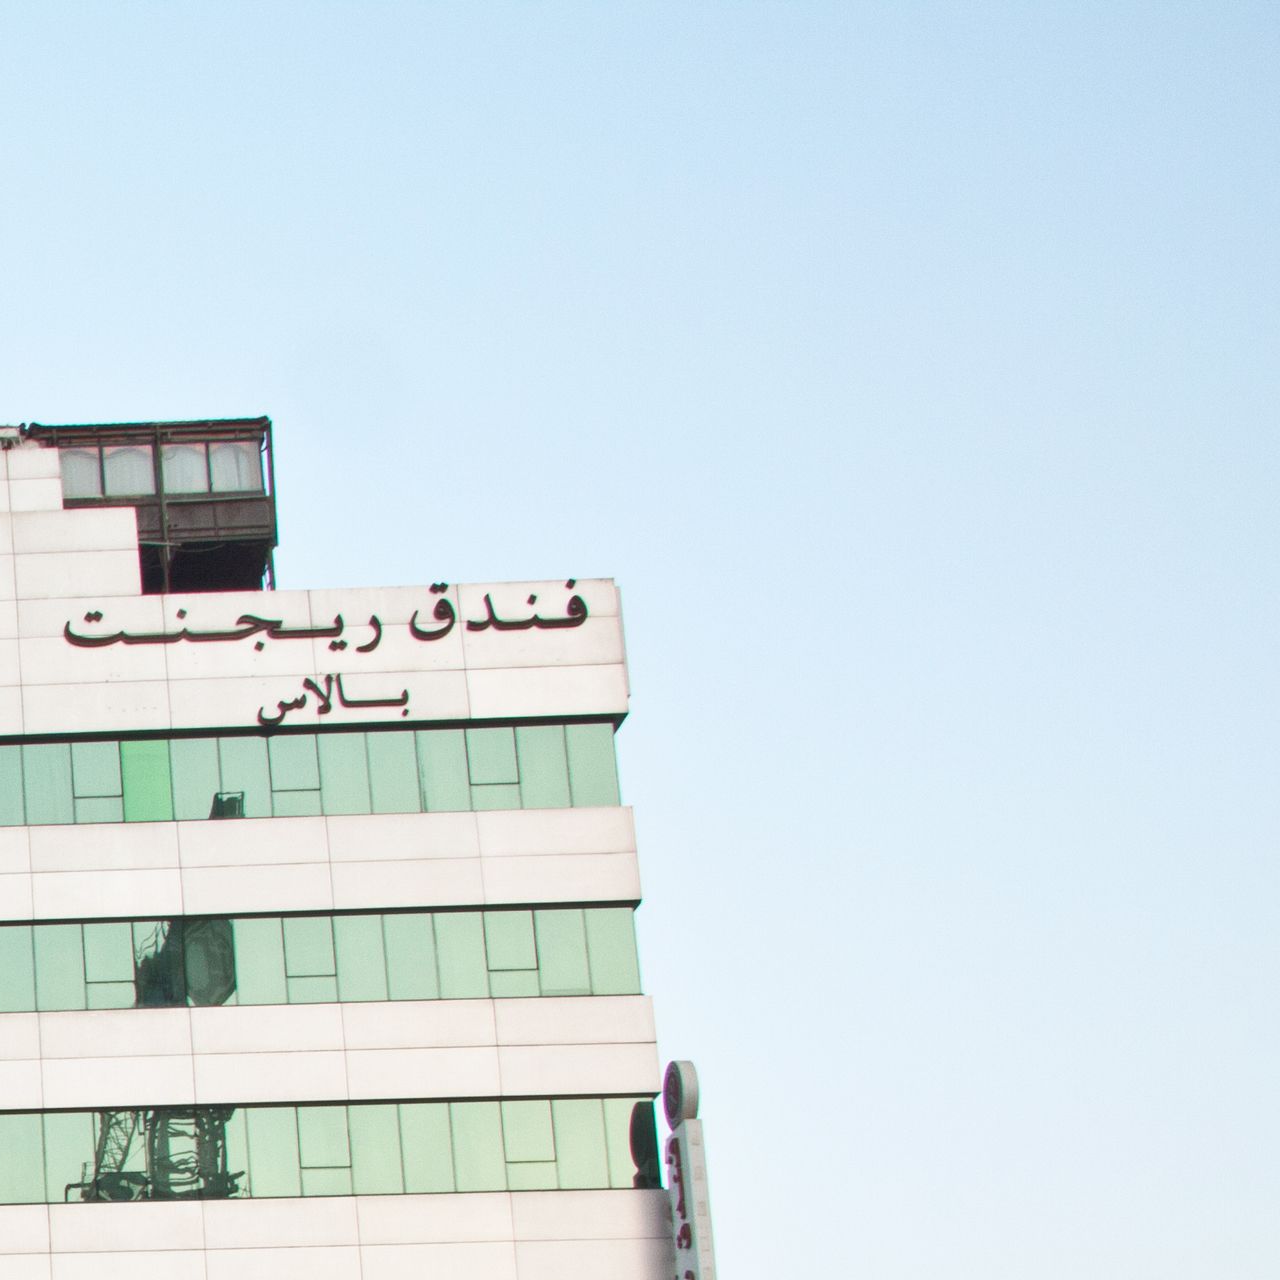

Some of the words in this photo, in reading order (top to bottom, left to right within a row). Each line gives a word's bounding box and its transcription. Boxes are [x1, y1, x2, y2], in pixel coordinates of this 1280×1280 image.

[64, 608, 382, 653] ريجنت
[409, 579, 589, 642] فندق
[257, 673, 409, 725] بالاس
